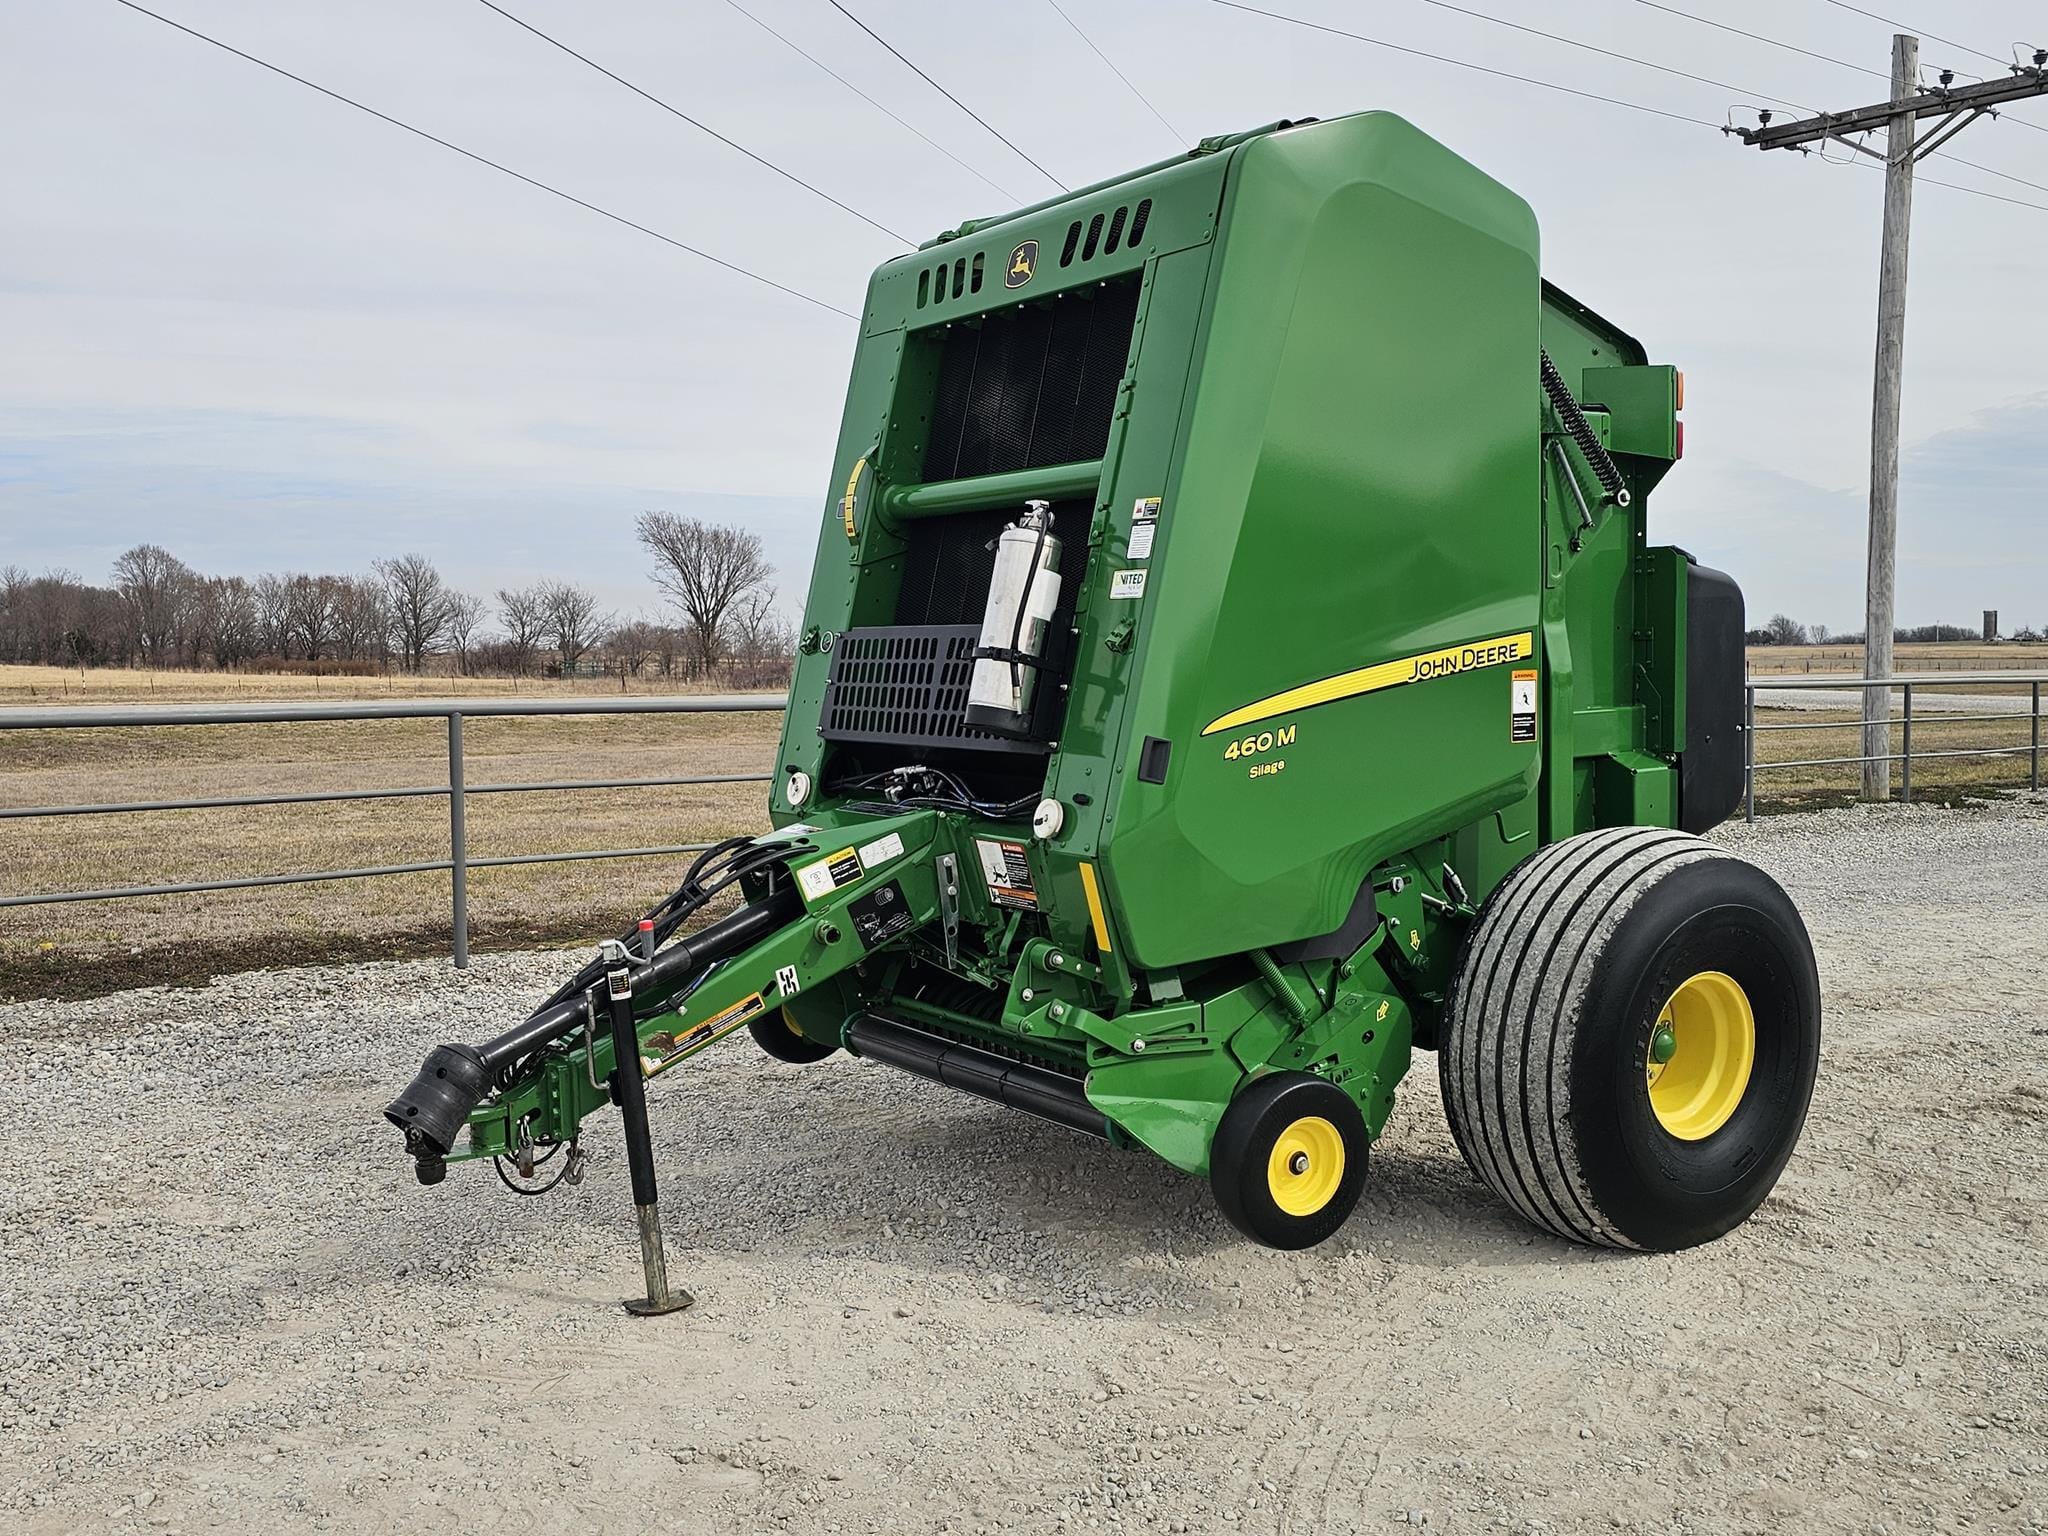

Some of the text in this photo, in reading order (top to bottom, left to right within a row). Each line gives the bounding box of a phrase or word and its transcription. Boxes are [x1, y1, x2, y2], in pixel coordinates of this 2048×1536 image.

[1408, 643, 1518, 680] JOHN DEERE
[1224, 723, 1297, 761] 460 M
[1248, 759, 1286, 779] Silage
